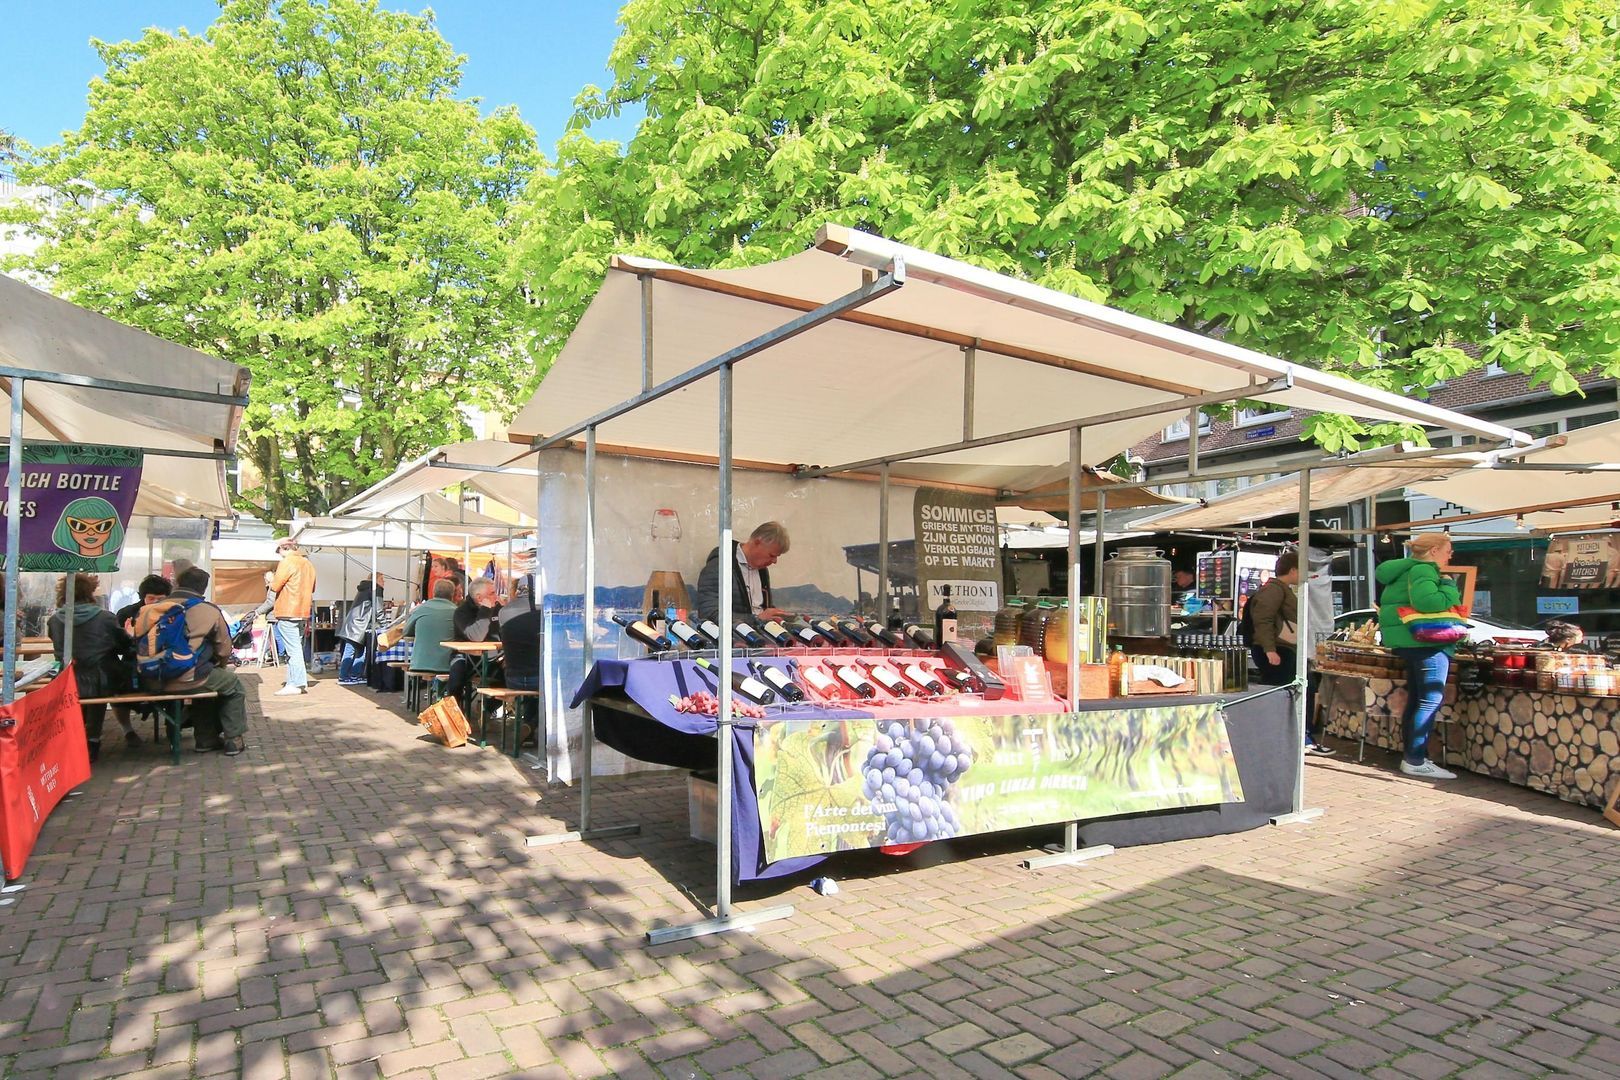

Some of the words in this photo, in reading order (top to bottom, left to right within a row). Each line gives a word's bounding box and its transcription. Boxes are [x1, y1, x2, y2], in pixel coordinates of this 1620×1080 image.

[56, 473, 122, 491] BOTTLE
[920, 504, 995, 524] SOMMIGE
[921, 521, 958, 532] GRIEKSE
[923, 532, 947, 543] ZIJN
[949, 534, 995, 546] GEWOON
[923, 544, 995, 556] VERKRIJGBAAR
[924, 555, 940, 566] OP
[943, 556, 959, 566] DE
[962, 556, 996, 568] MARKT
[1571, 567, 1598, 576] KITCHEN
[806, 815, 887, 837] Piemontesi
